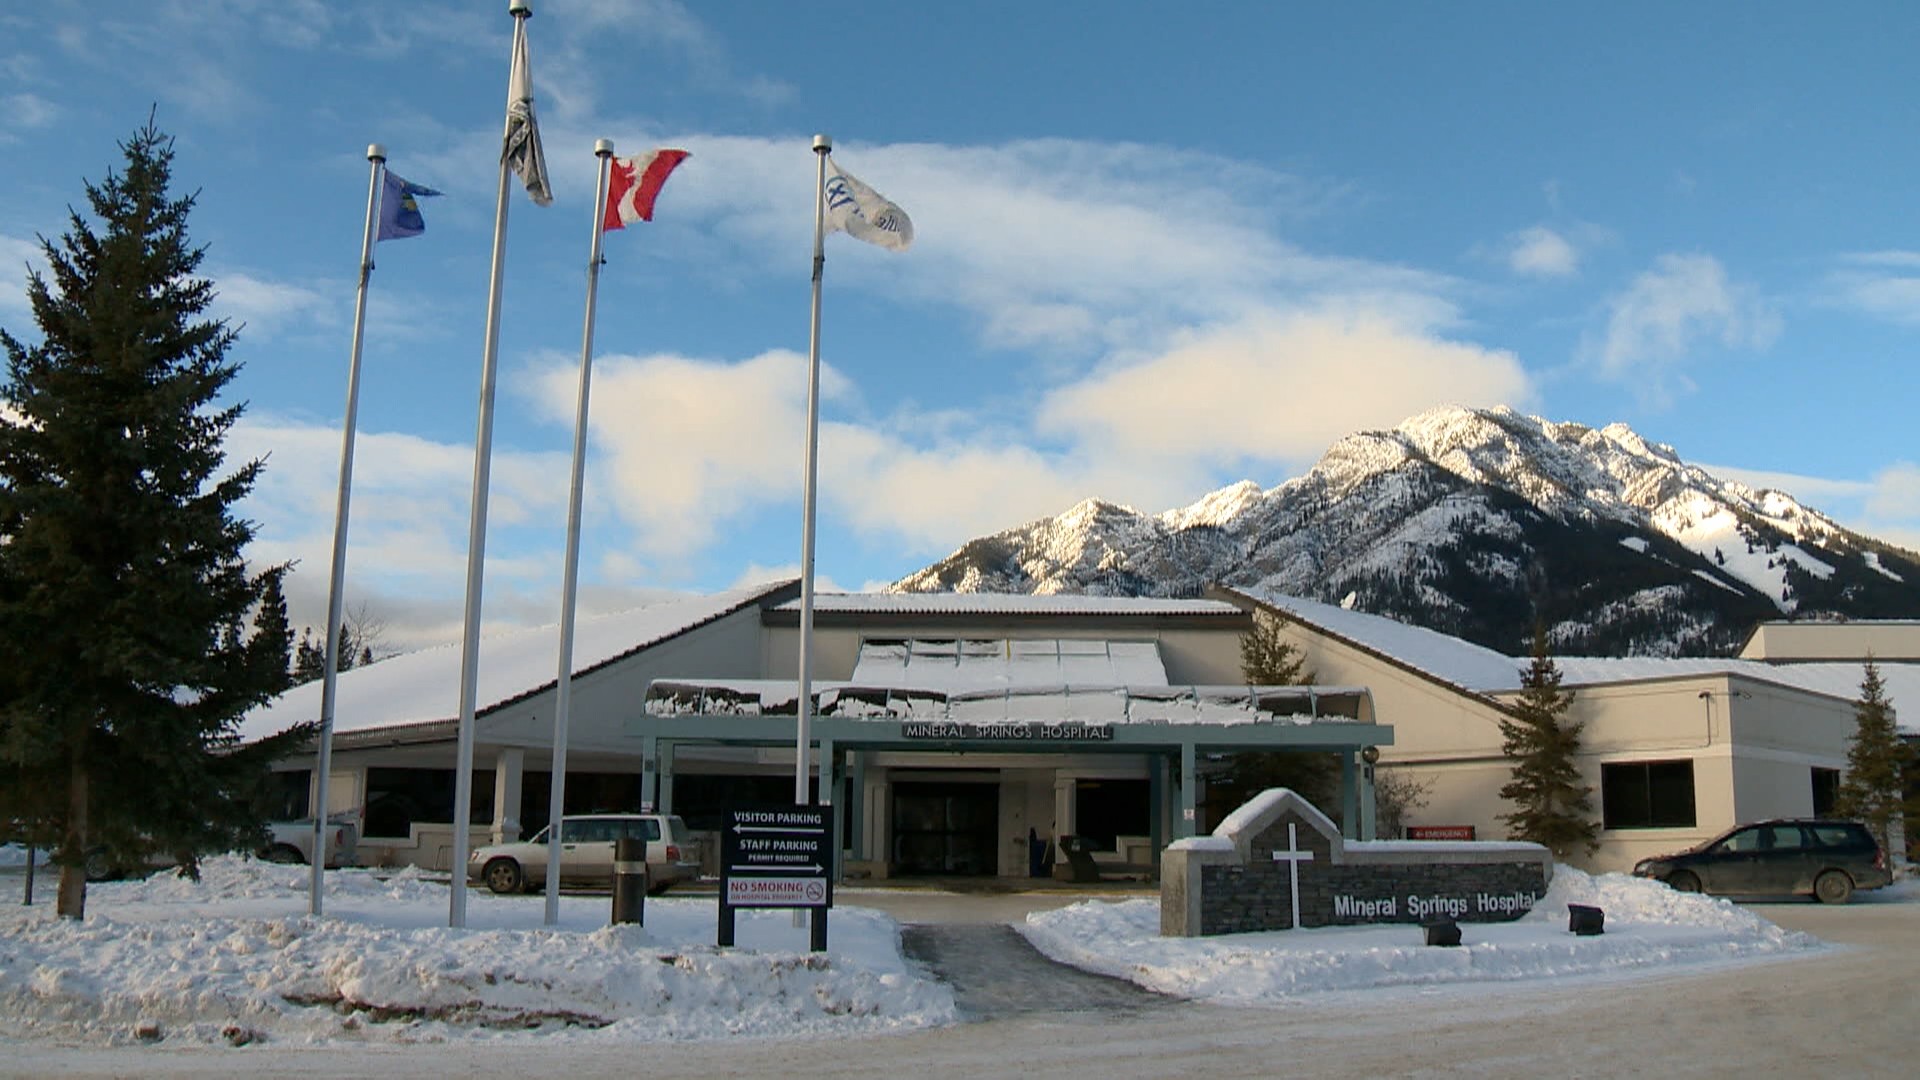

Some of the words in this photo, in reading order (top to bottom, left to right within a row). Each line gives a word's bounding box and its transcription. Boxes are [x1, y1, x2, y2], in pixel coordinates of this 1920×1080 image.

[907, 726, 965, 738] MINERAL
[976, 726, 1032, 739] SPRINGS
[1041, 726, 1108, 739] HOSPITAL
[734, 811, 774, 822] VISITOR
[777, 813, 821, 824] PARKING
[740, 839, 770, 850] STAFF
[773, 841, 817, 850] PARKING
[731, 883, 748, 892] NO
[751, 883, 803, 893] SMOKING
[1334, 895, 1396, 916] Mineral
[1407, 894, 1467, 918] Springs
[1477, 891, 1536, 914] Hospital
